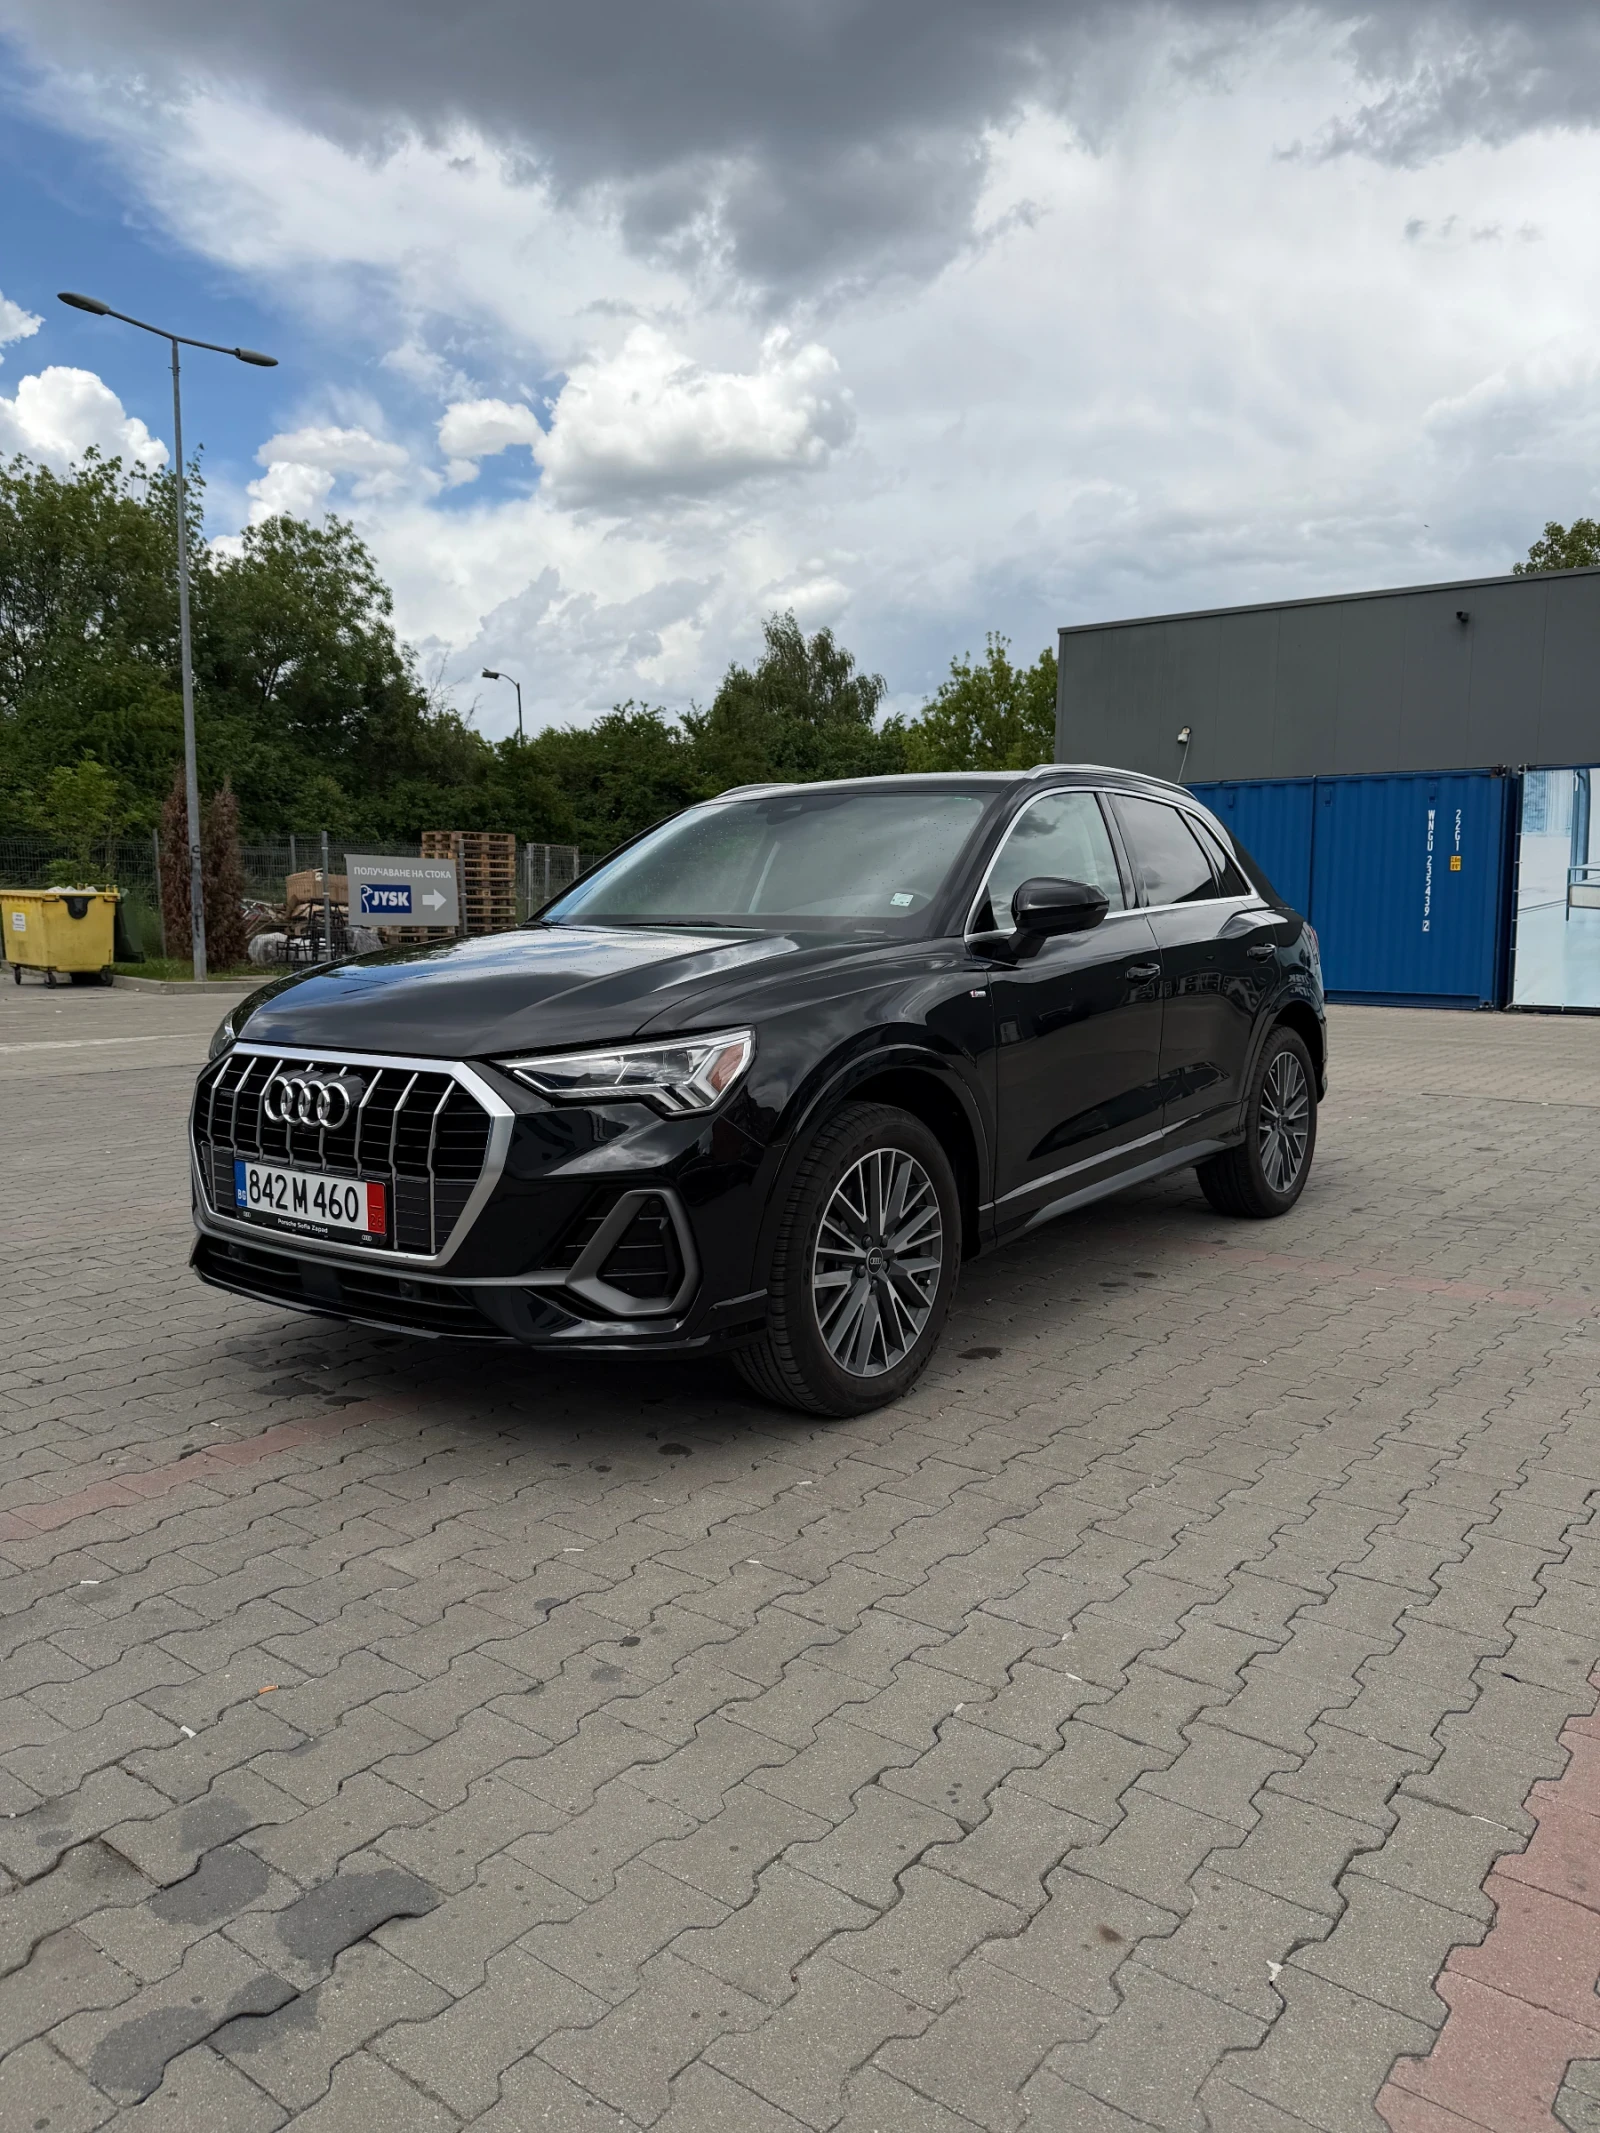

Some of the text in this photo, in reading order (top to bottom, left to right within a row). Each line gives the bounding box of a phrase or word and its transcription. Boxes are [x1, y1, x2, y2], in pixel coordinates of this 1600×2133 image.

[353, 866, 452, 879] ПОЛУЧАВАНЕ НА СТОКА
[1423, 809, 1435, 932] WNGU 235439 2
[371, 891, 410, 907] JYSK
[237, 1188, 247, 1201] BG
[277, 1217, 297, 1228] Porsche
[297, 1222, 311, 1230] Sofia
